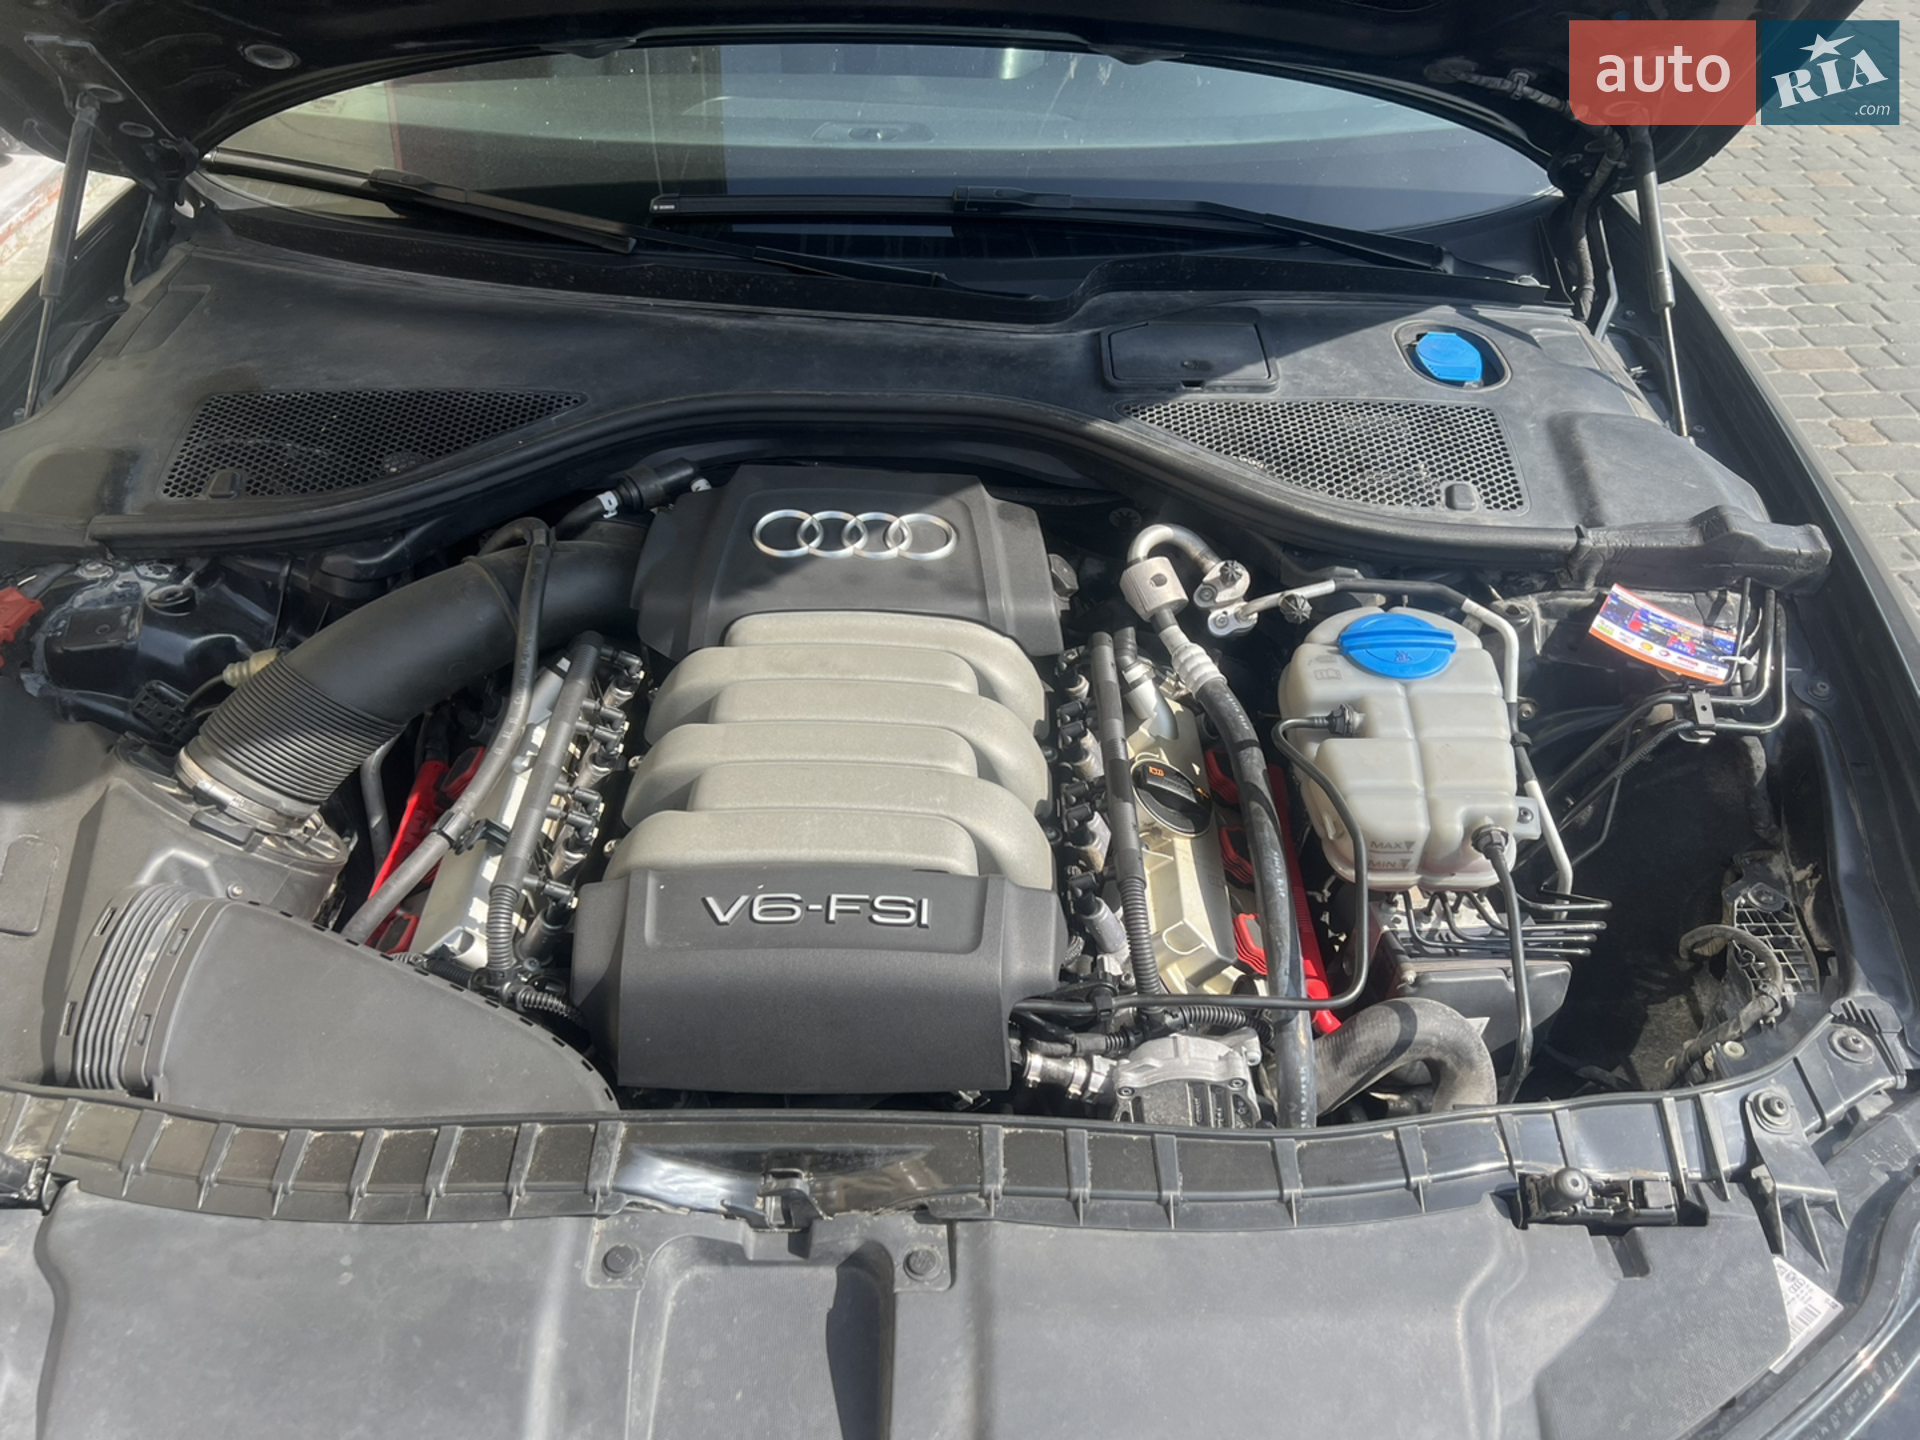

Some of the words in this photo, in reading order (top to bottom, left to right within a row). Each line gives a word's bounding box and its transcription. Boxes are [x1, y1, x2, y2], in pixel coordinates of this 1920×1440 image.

[1369, 840, 1402, 850] MAX
[1367, 859, 1396, 868] MIN
[702, 893, 929, 928] V6-FSI
